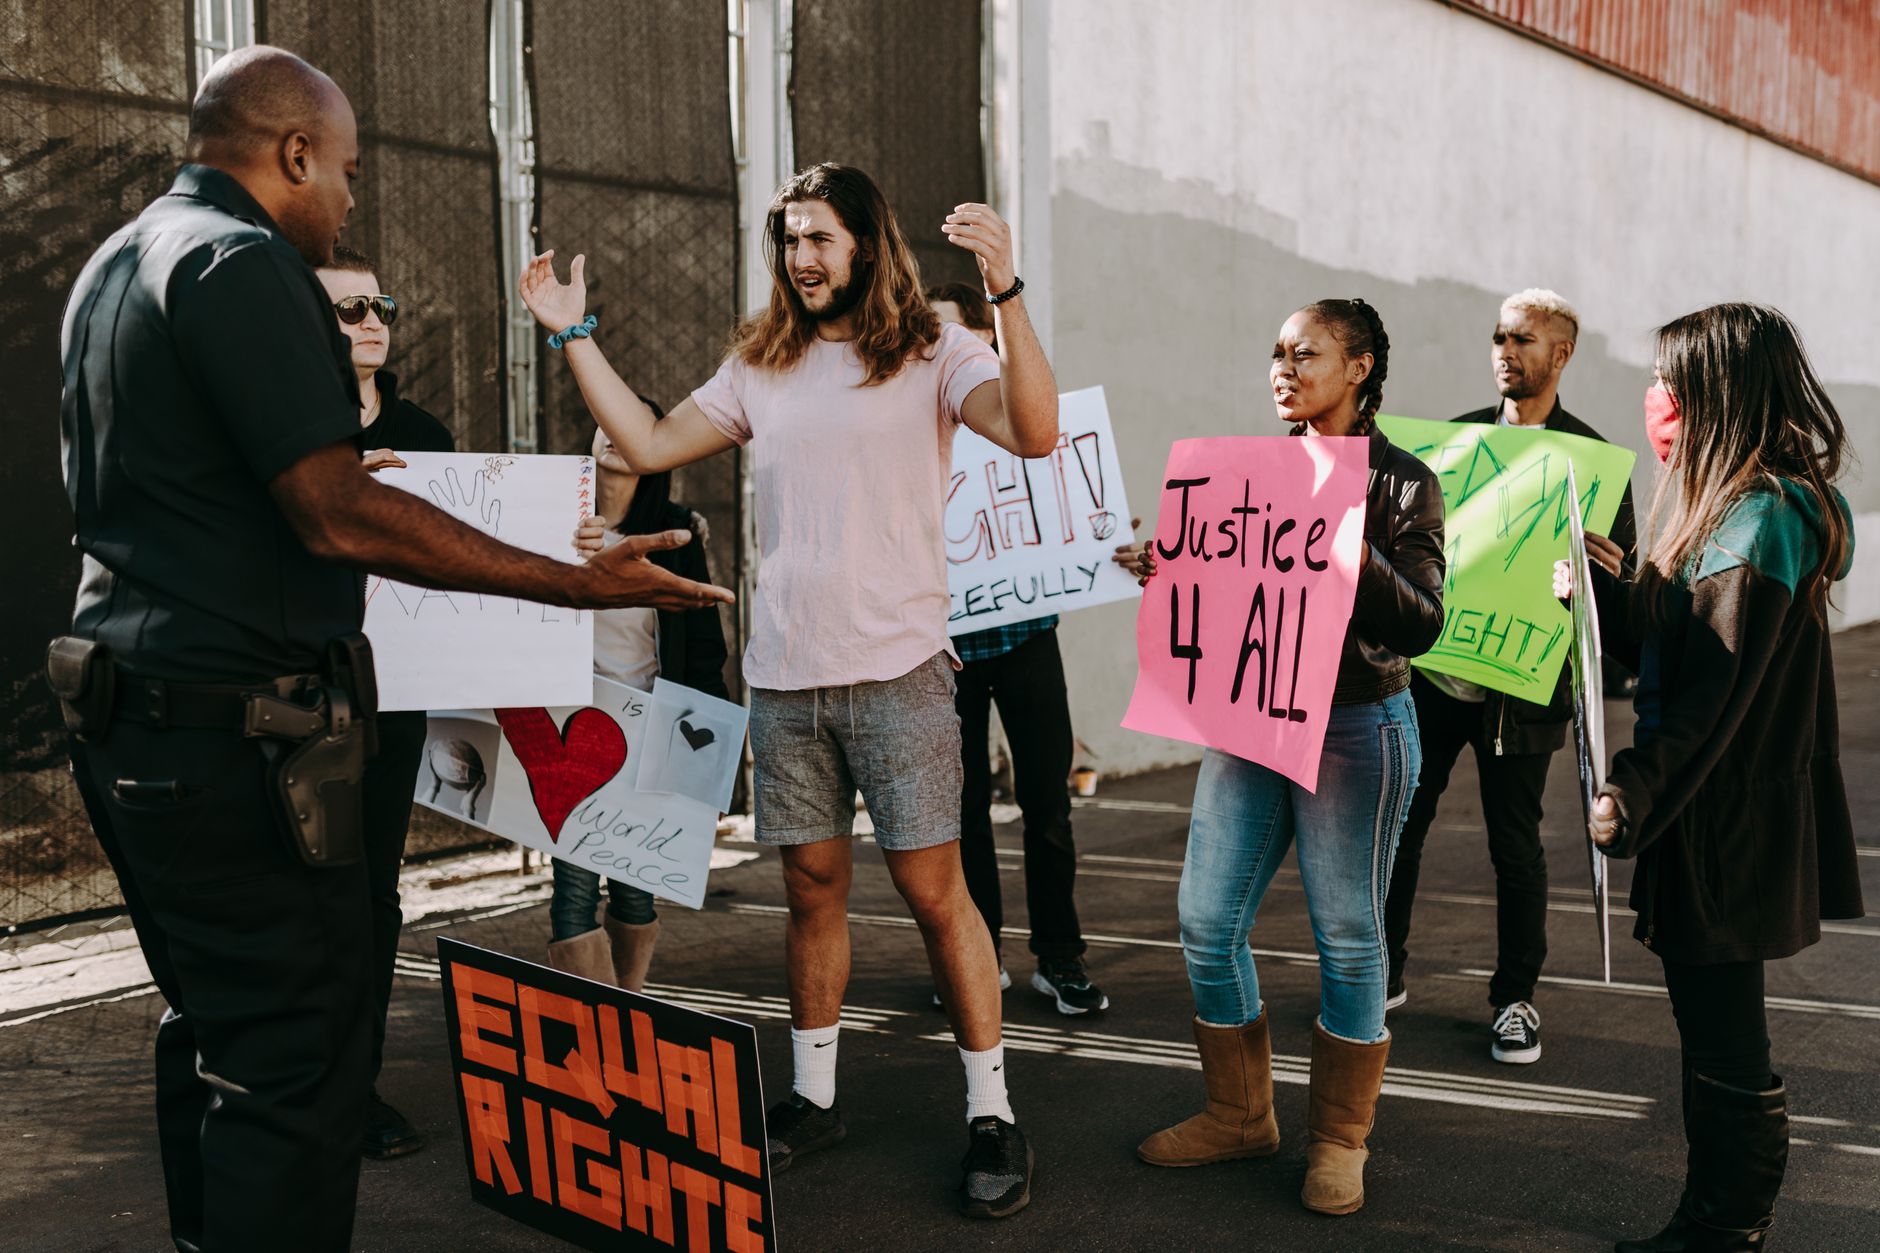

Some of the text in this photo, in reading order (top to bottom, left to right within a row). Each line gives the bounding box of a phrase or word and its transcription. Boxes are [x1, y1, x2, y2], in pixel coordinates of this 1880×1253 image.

[943, 432, 1112, 565] GHT!
[1157, 477, 1329, 573] Justice
[1170, 582, 1308, 723] 4 ALL
[1439, 606, 1565, 673] IGHT!
[622, 697, 644, 717] is
[572, 798, 683, 862] World
[450, 961, 761, 1179] EQUAL
